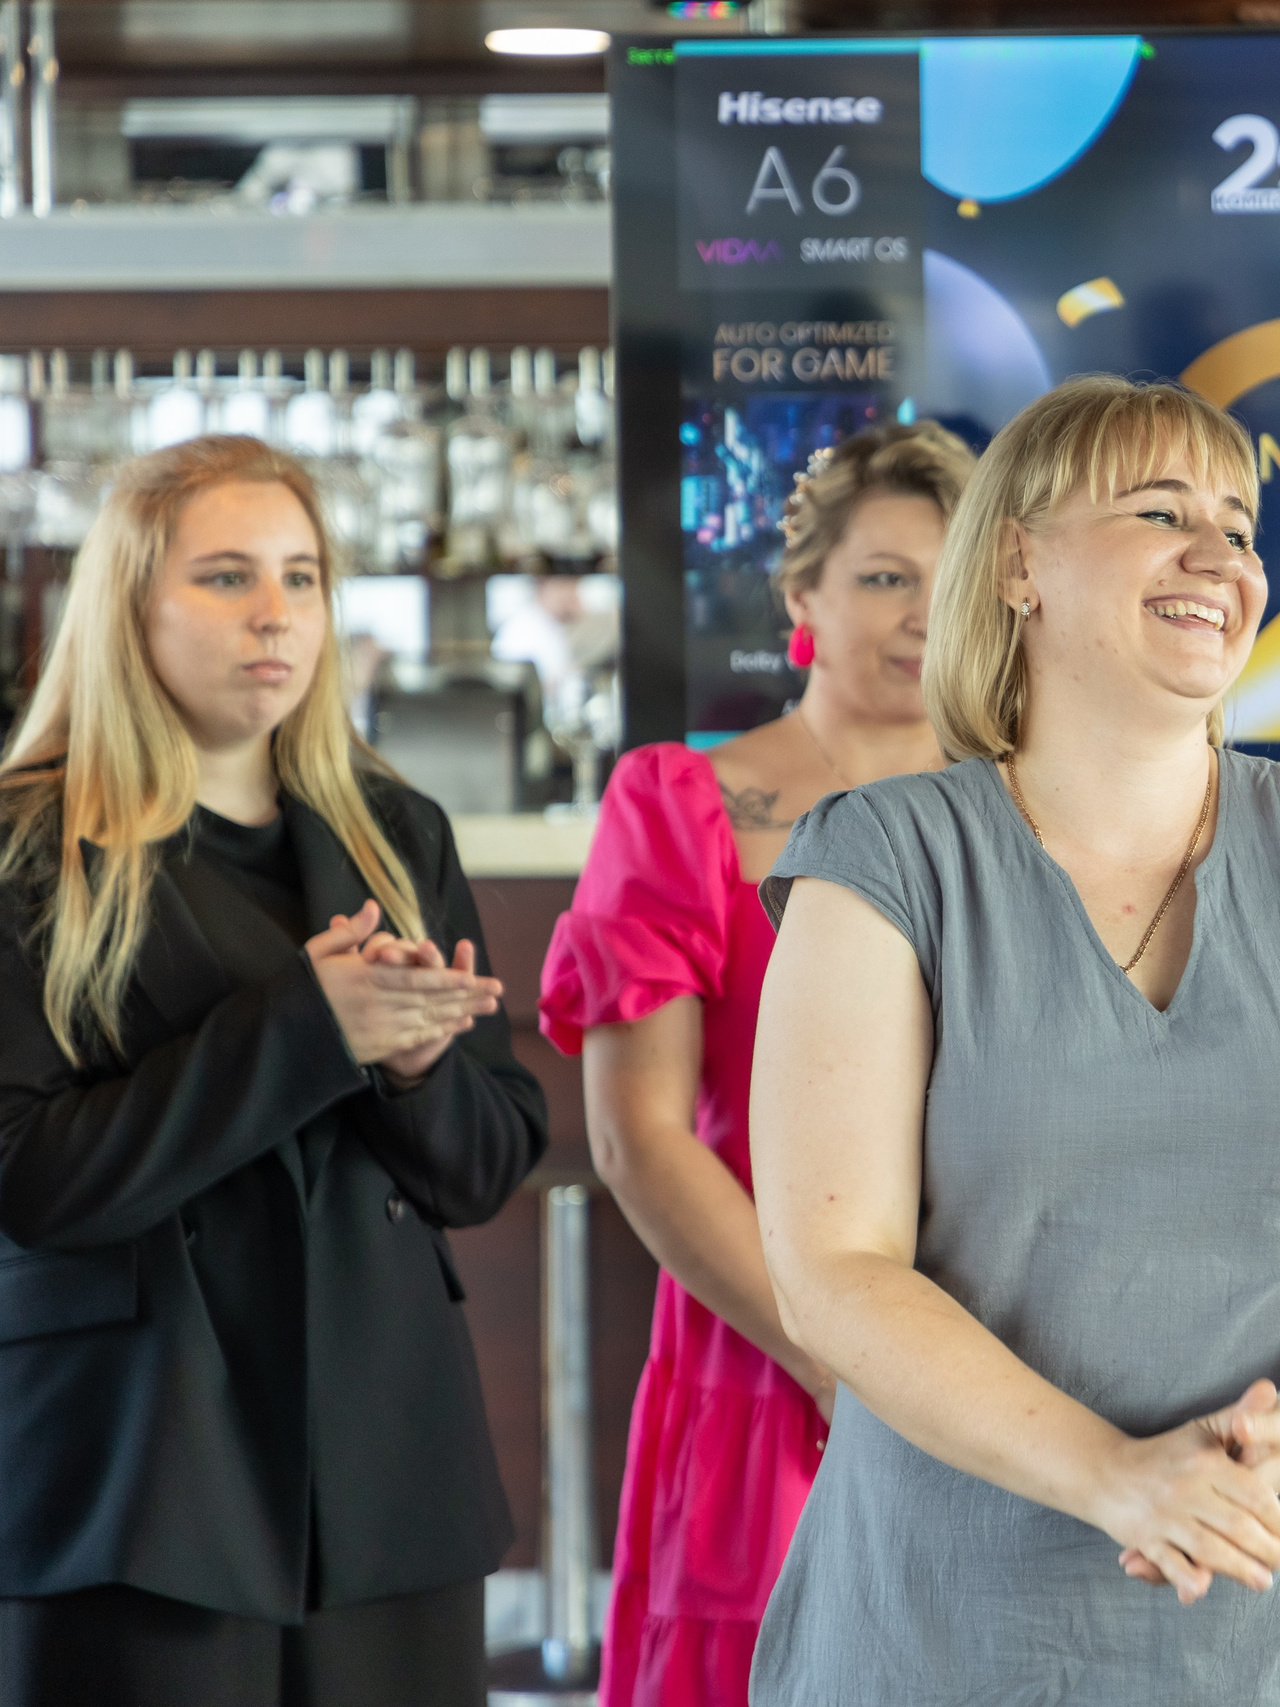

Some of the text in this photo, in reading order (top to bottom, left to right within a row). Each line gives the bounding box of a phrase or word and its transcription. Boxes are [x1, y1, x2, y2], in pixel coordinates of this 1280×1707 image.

[718, 91, 884, 125] Hisense
[800, 237, 871, 263] SMART
[874, 236, 910, 263] OS
[714, 320, 896, 346] AUTO OPTIMIZED
[712, 346, 896, 384] FOR GAME
